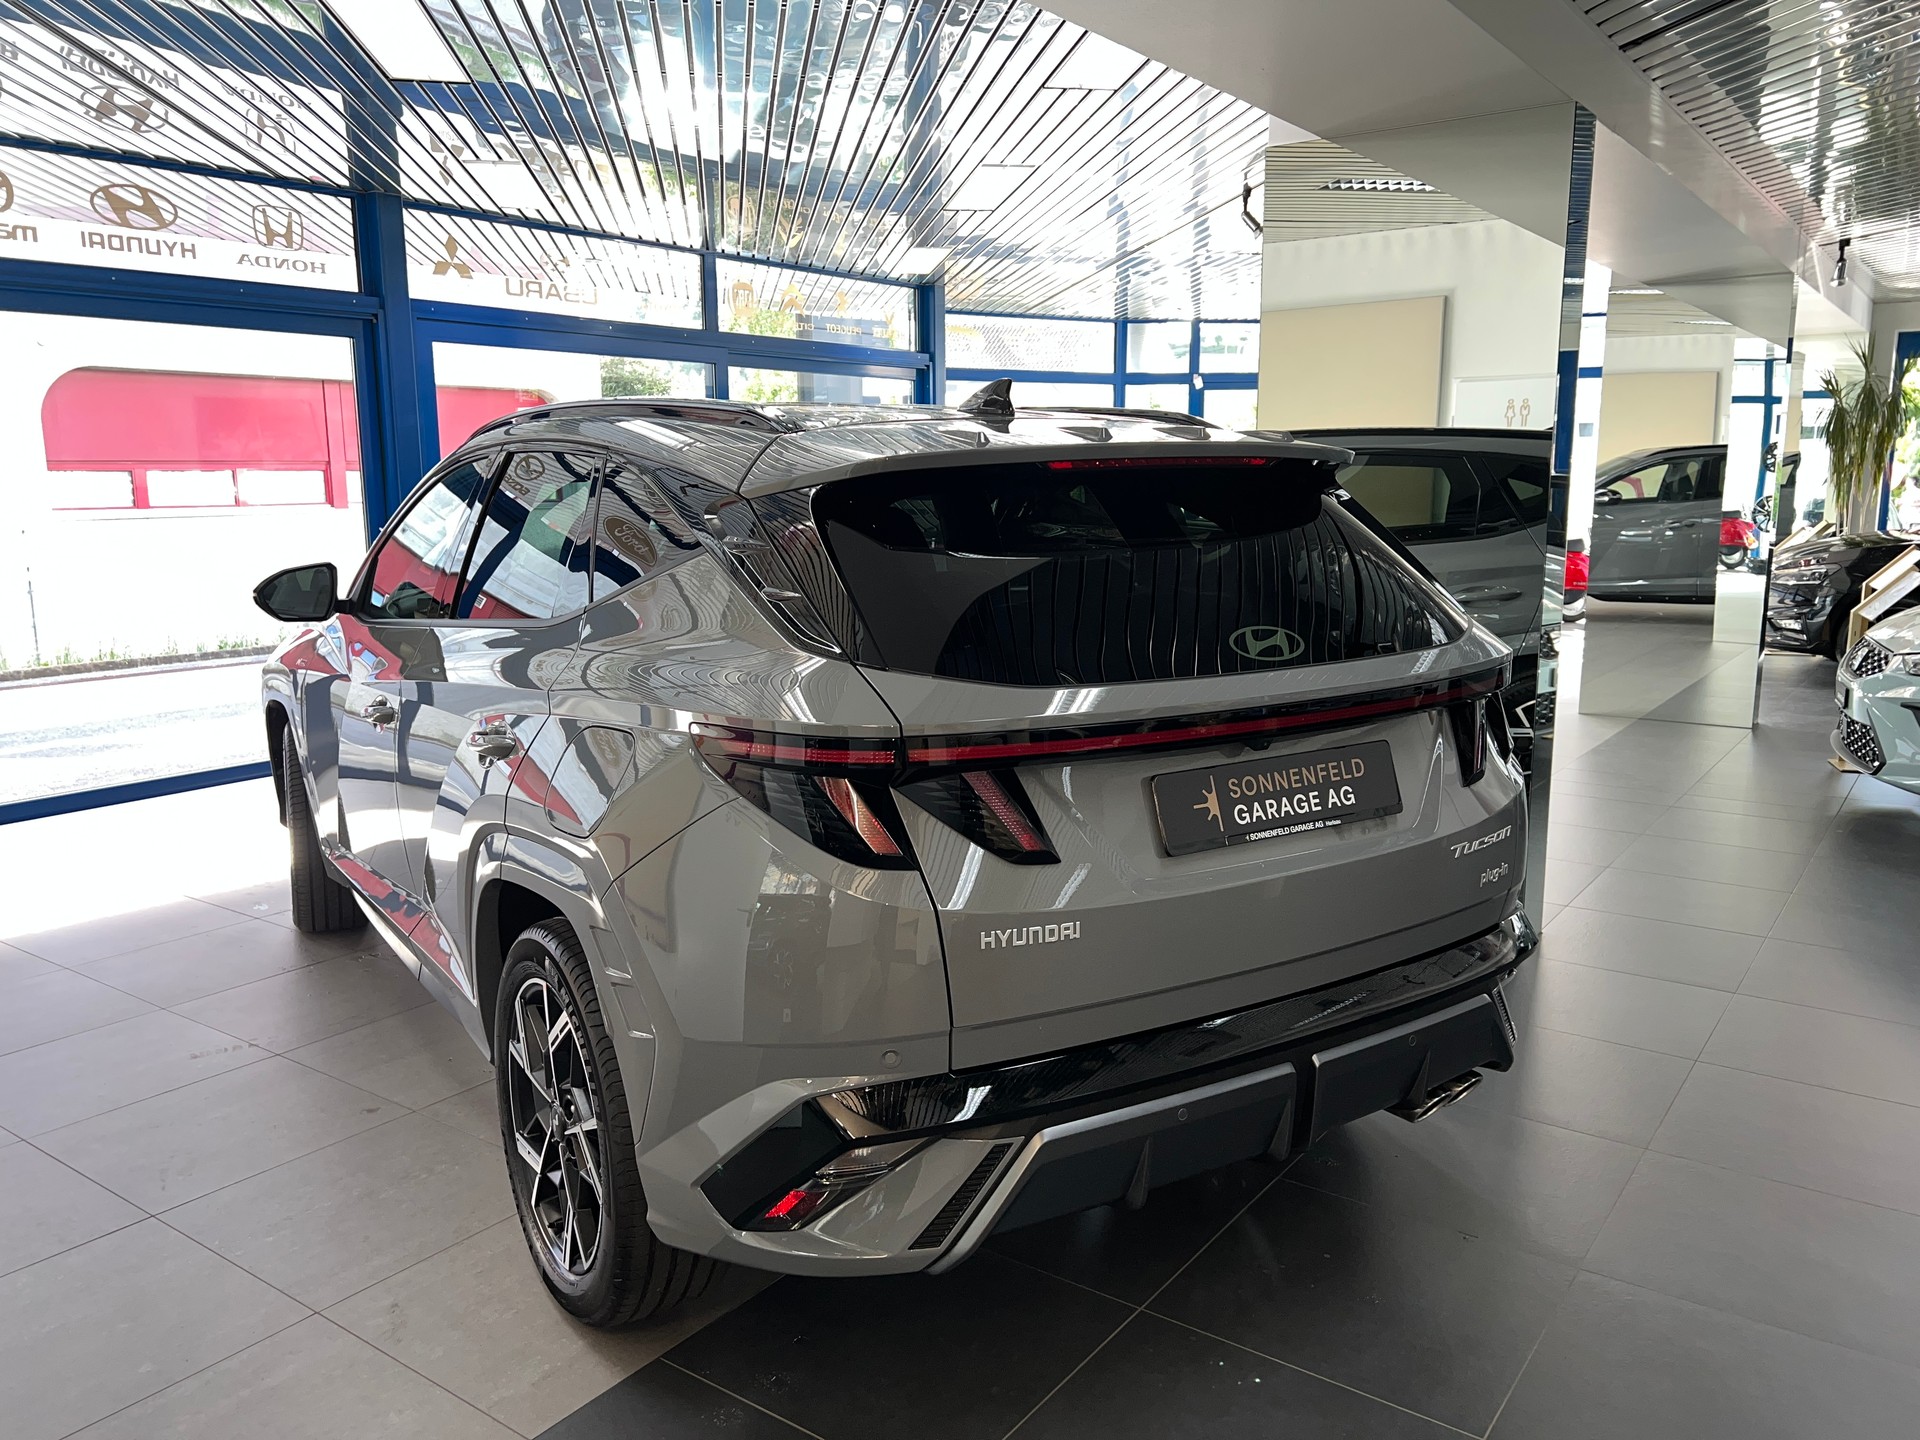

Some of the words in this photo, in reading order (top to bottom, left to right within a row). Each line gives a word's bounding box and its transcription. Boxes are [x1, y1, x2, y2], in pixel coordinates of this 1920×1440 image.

[614, 523, 648, 557] Ford
[1228, 757, 1366, 799] SONNENFELD
[1233, 785, 1322, 826] GARAGE
[1328, 785, 1356, 807] AG
[1249, 827, 1290, 841] SONNENFELD
[1290, 822, 1315, 833] GARAGE
[1315, 820, 1324, 829] AG
[1480, 862, 1509, 888] plug-in
[980, 920, 1082, 950] HYUNDAI
